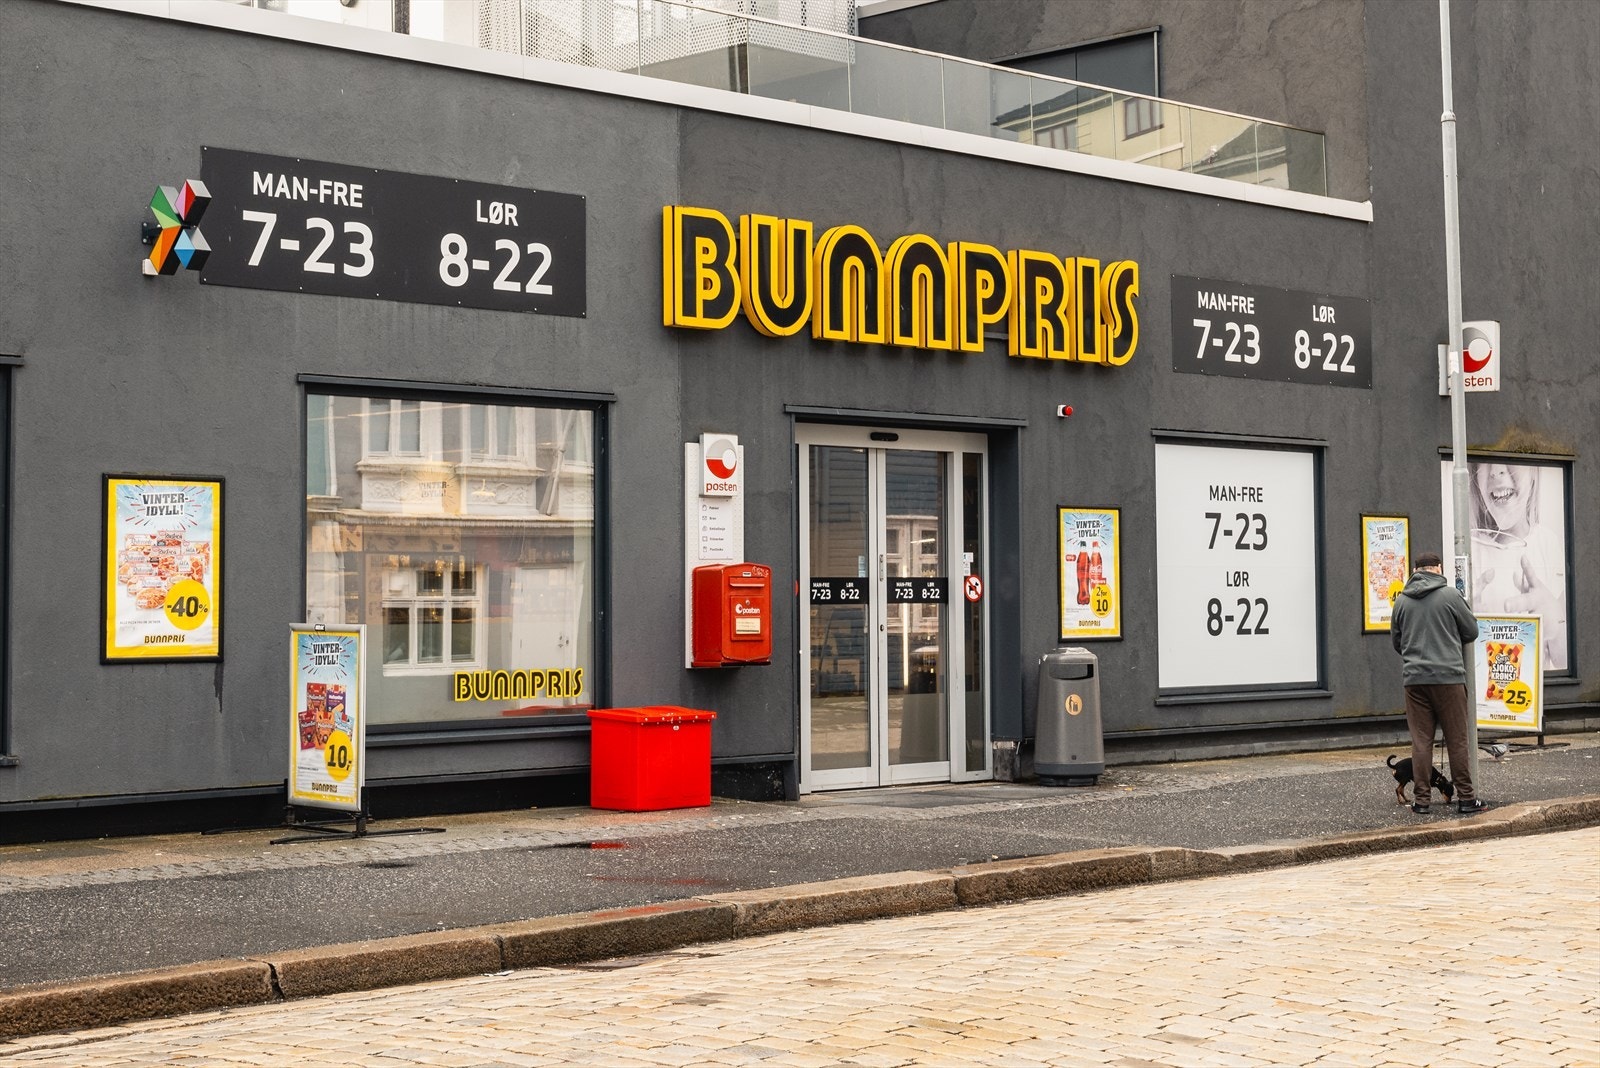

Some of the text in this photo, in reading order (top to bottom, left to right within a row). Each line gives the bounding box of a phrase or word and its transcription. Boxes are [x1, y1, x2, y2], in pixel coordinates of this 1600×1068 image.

[253, 171, 363, 208] MAN-FRE
[476, 200, 519, 227] LØR
[242, 210, 375, 277] 7-23
[439, 233, 553, 295] 8-22
[663, 205, 1140, 367] BUNNPRIS
[1197, 290, 1255, 315] MAN-FRE
[1312, 304, 1335, 324] LØR
[1193, 318, 1261, 365] 7-23
[1294, 329, 1356, 373] 8-22
[1464, 375, 1493, 387] sten
[705, 481, 738, 493] posten
[143, 493, 189, 505] VINTER-
[1209, 485, 1263, 503] MAN-FRE
[146, 505, 184, 516] IDYLL!
[1076, 520, 1103, 529] VINTER-
[1078, 529, 1100, 538] IDYLL!
[1205, 512, 1268, 551] 7-23
[1226, 571, 1250, 588] LØR
[811, 589, 831, 600] 7-23
[840, 589, 860, 600] 8-22
[895, 588, 914, 599] 7-23
[922, 588, 940, 599] 8-22
[1096, 599, 1109, 612] 10
[1207, 597, 1269, 636] 8-22
[1490, 625, 1521, 633] VINTER-
[144, 635, 186, 644] BUNNPRIS
[313, 643, 343, 654] VINTER-
[315, 655, 339, 665] IDYLL!
[454, 667, 584, 702] BUNNPRIS
[311, 782, 338, 793] BUNNPRIS
